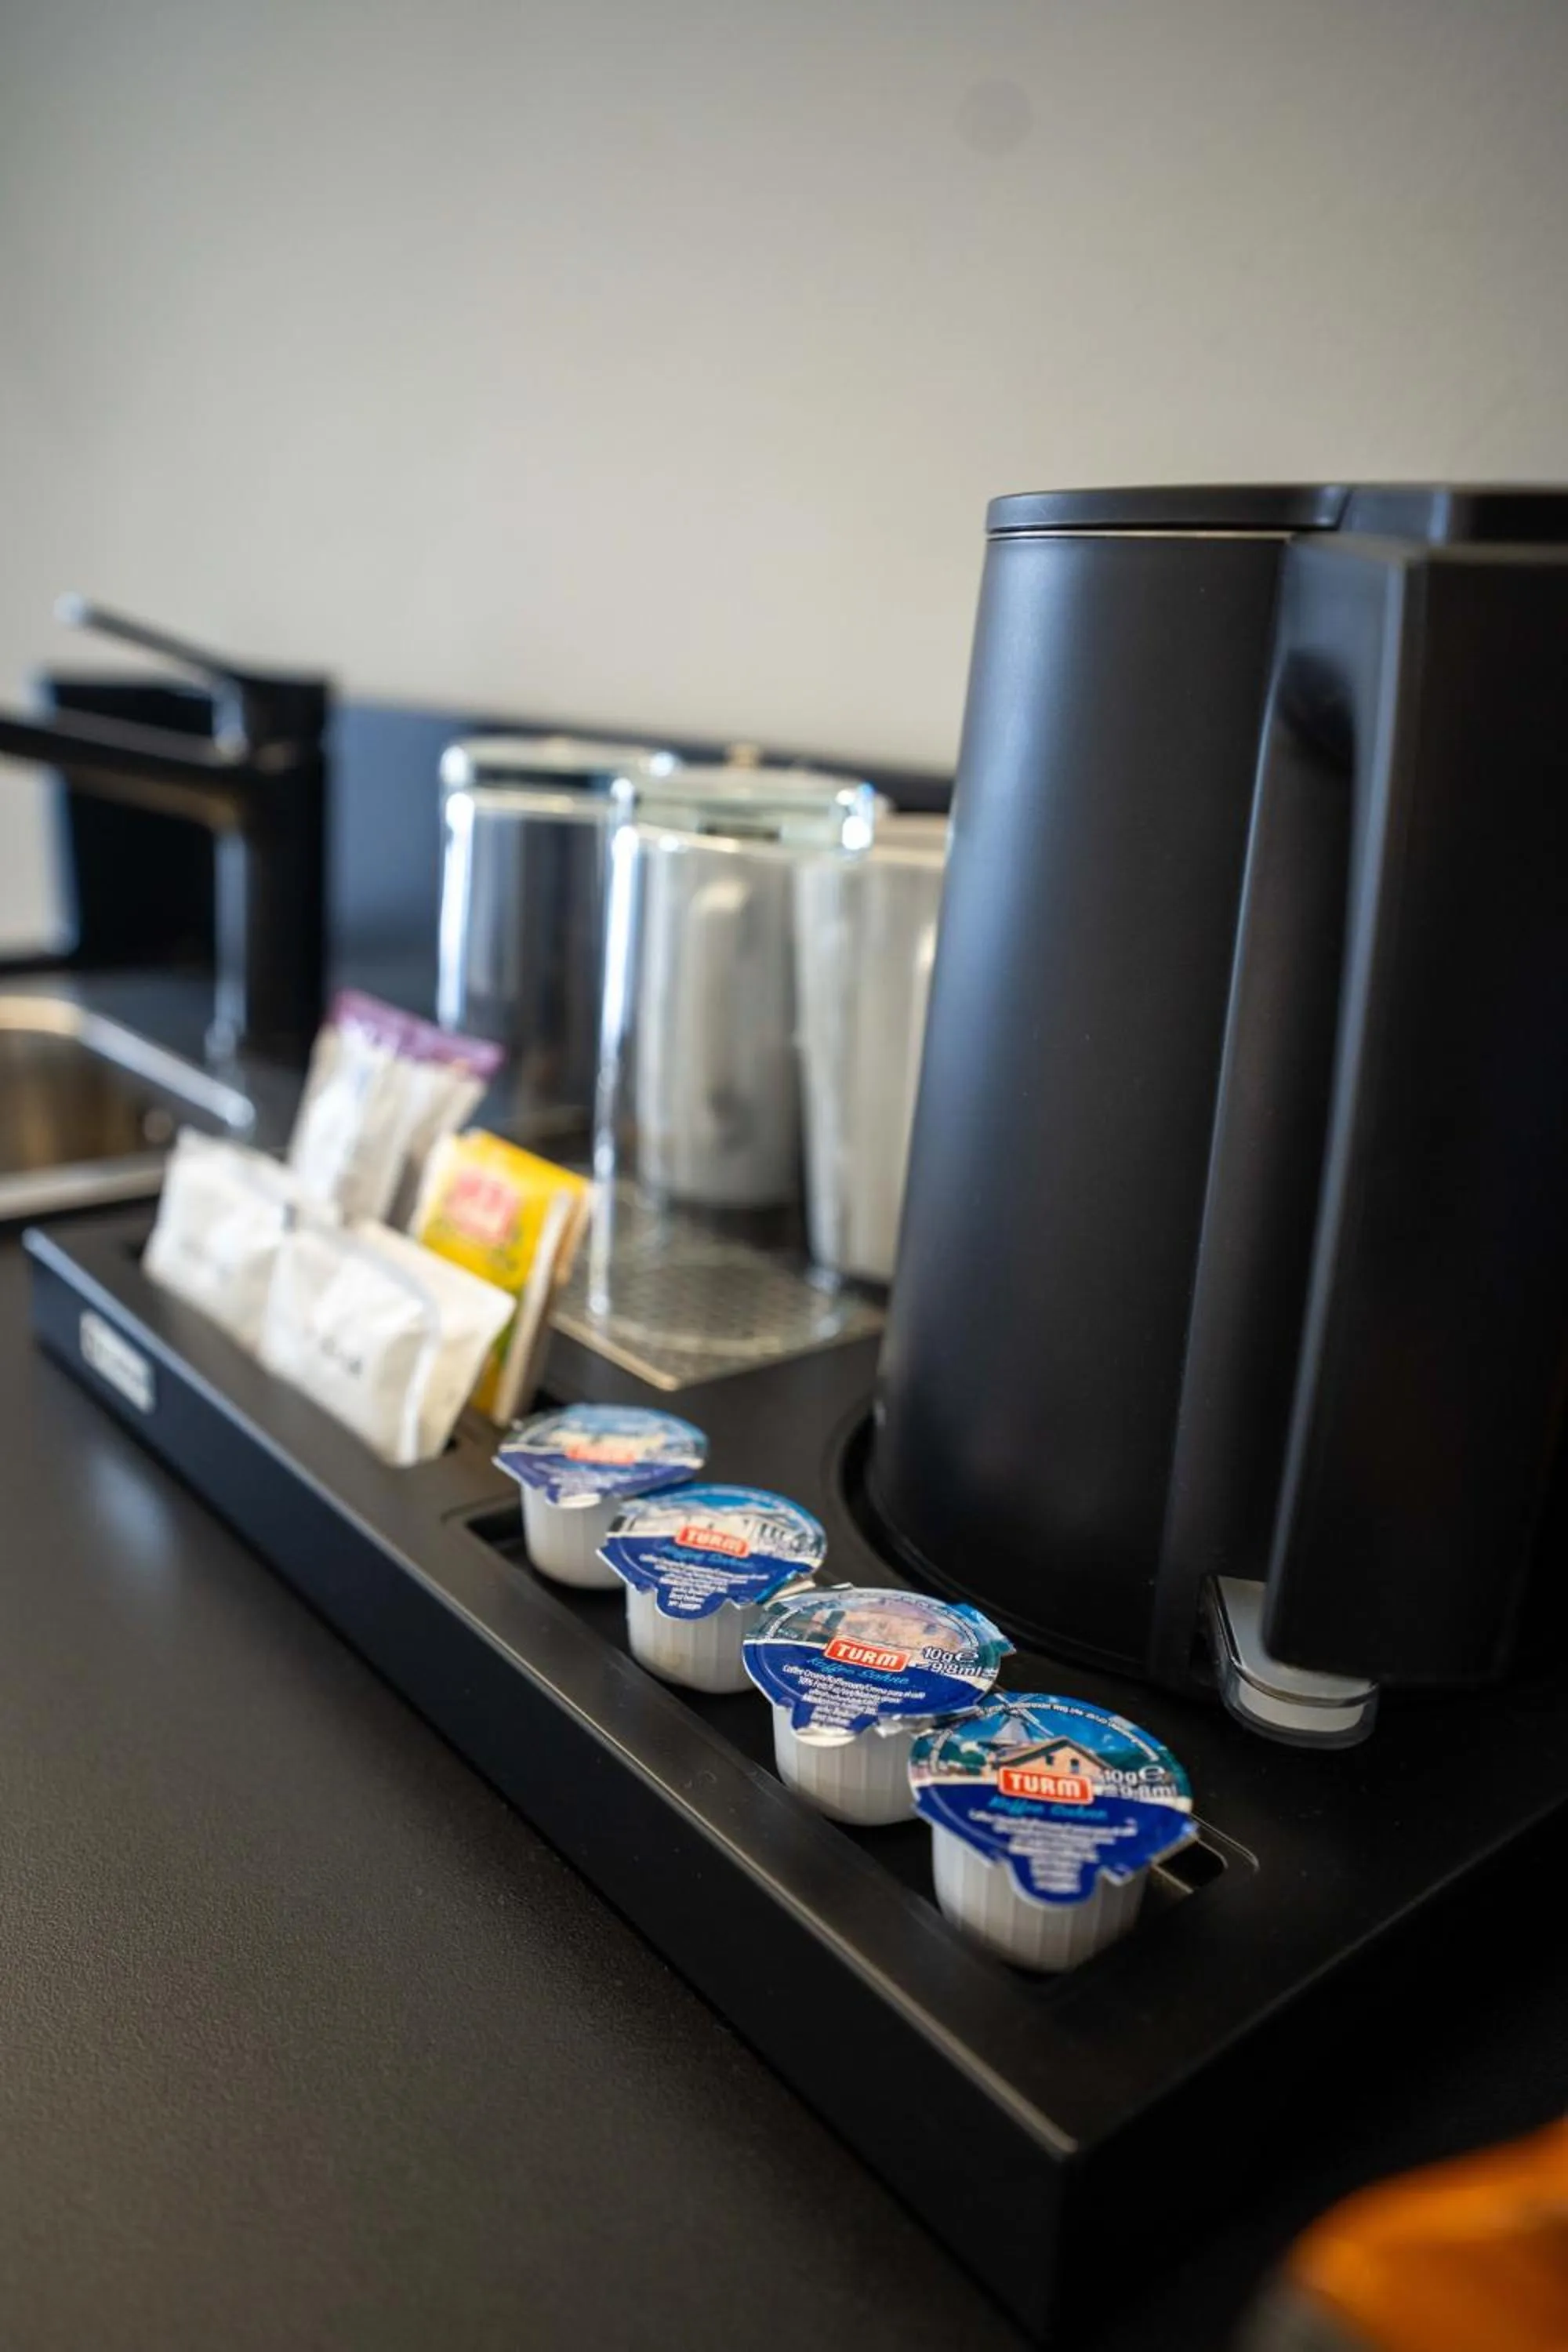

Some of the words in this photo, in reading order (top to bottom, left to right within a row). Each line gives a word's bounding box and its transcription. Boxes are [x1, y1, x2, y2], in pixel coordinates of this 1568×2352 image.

[837, 1643, 898, 1667] TURM
[924, 1647, 954, 1662] 10g
[1009, 1773, 1080, 1798] TURM
